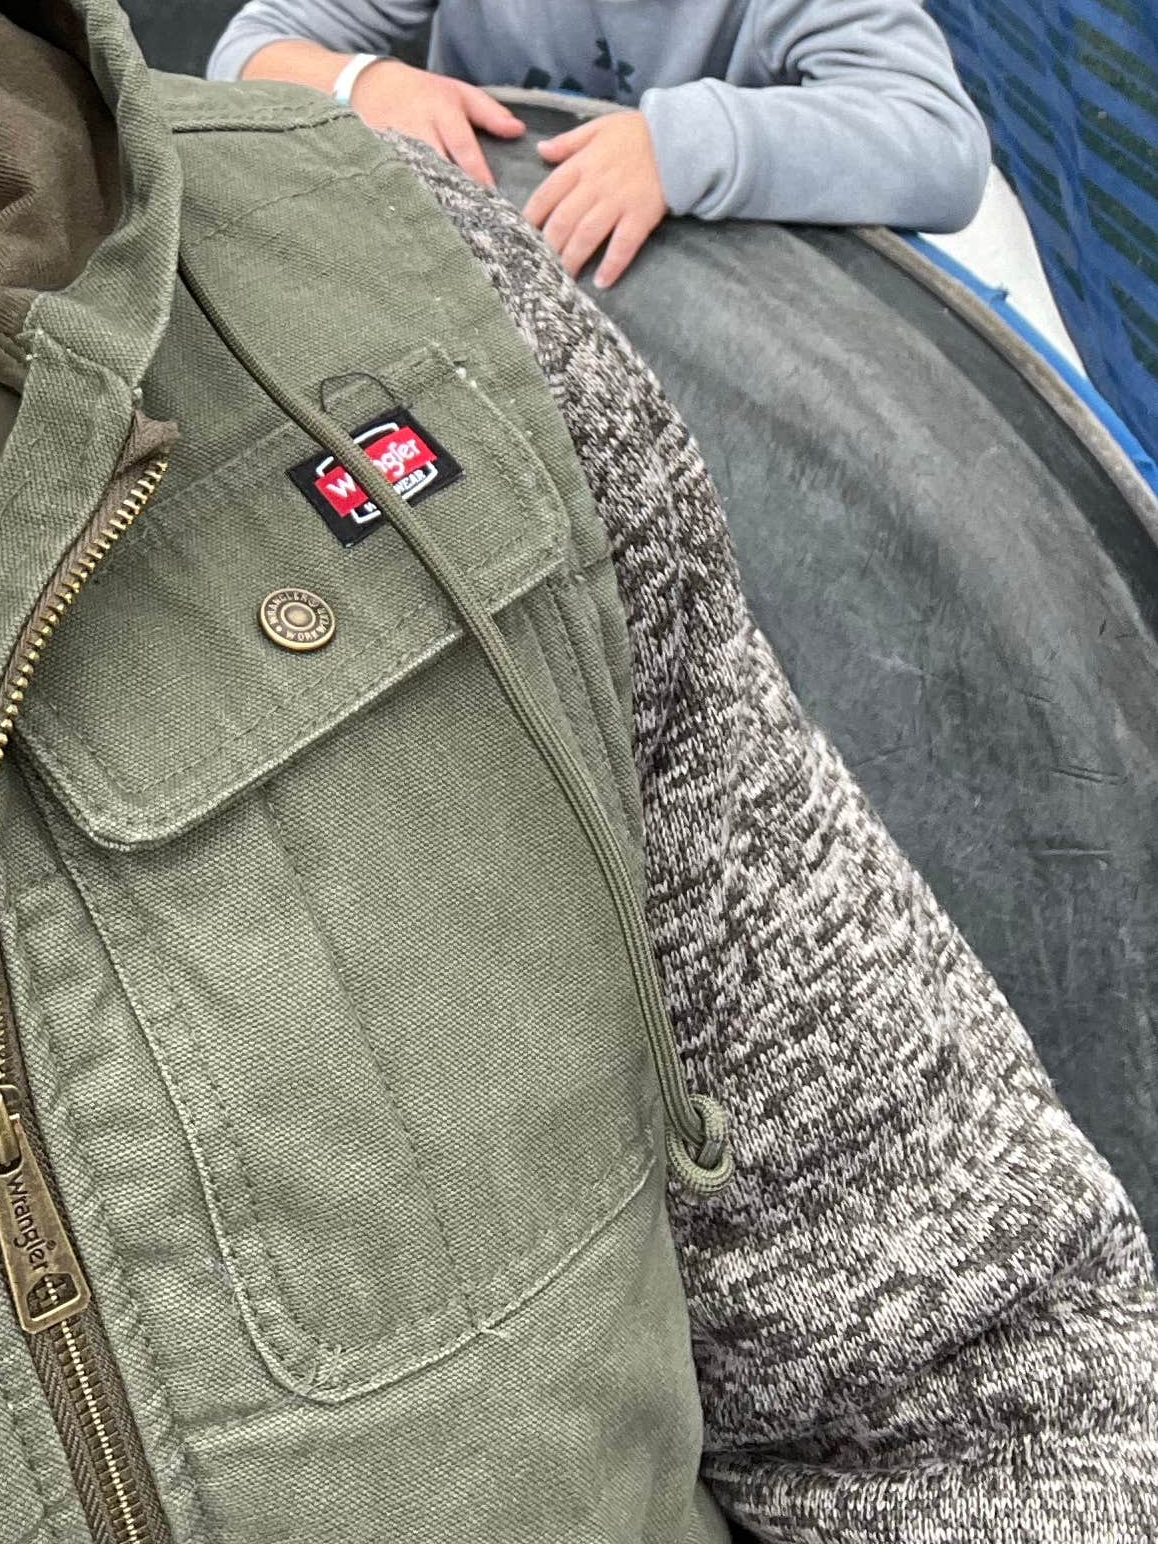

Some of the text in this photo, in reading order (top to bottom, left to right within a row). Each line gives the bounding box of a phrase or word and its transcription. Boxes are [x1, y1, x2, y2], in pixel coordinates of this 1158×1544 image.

[326, 439, 421, 498] Wngler
[363, 469, 427, 513] WWEAR
[6, 1172, 49, 1272] Wrangler
